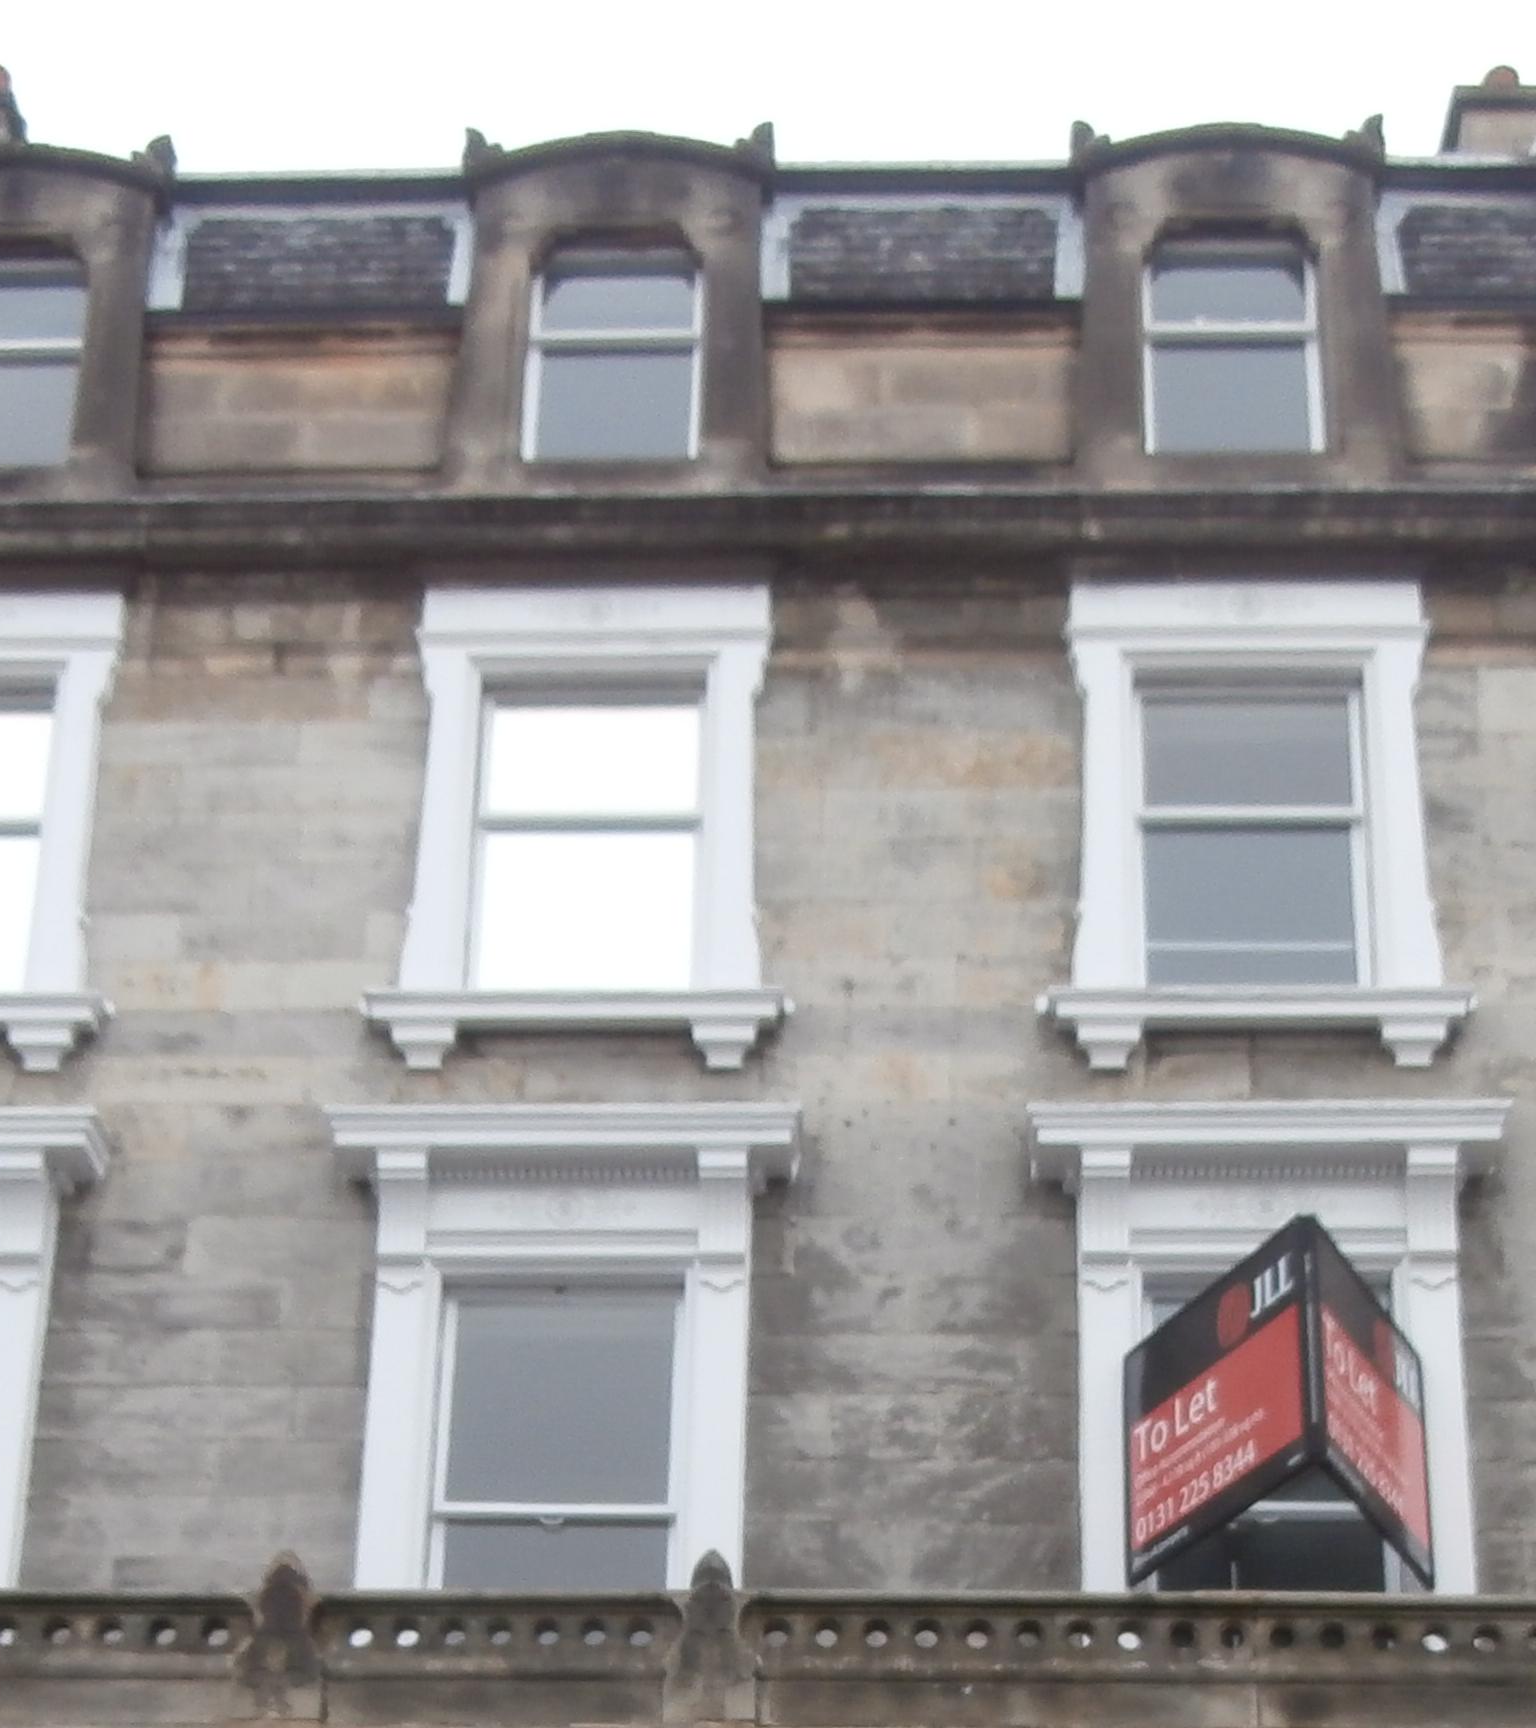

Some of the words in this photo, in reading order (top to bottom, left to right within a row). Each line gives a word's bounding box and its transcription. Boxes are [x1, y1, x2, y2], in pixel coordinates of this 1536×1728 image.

[1250, 1252, 1293, 1318] JLL
[1133, 1417, 1169, 1462] To
[1173, 1378, 1218, 1436] Let
[1135, 1497, 1175, 1543] 0131
[1179, 1471, 1211, 1514] 225
[1212, 1438, 1256, 1491] 8344
